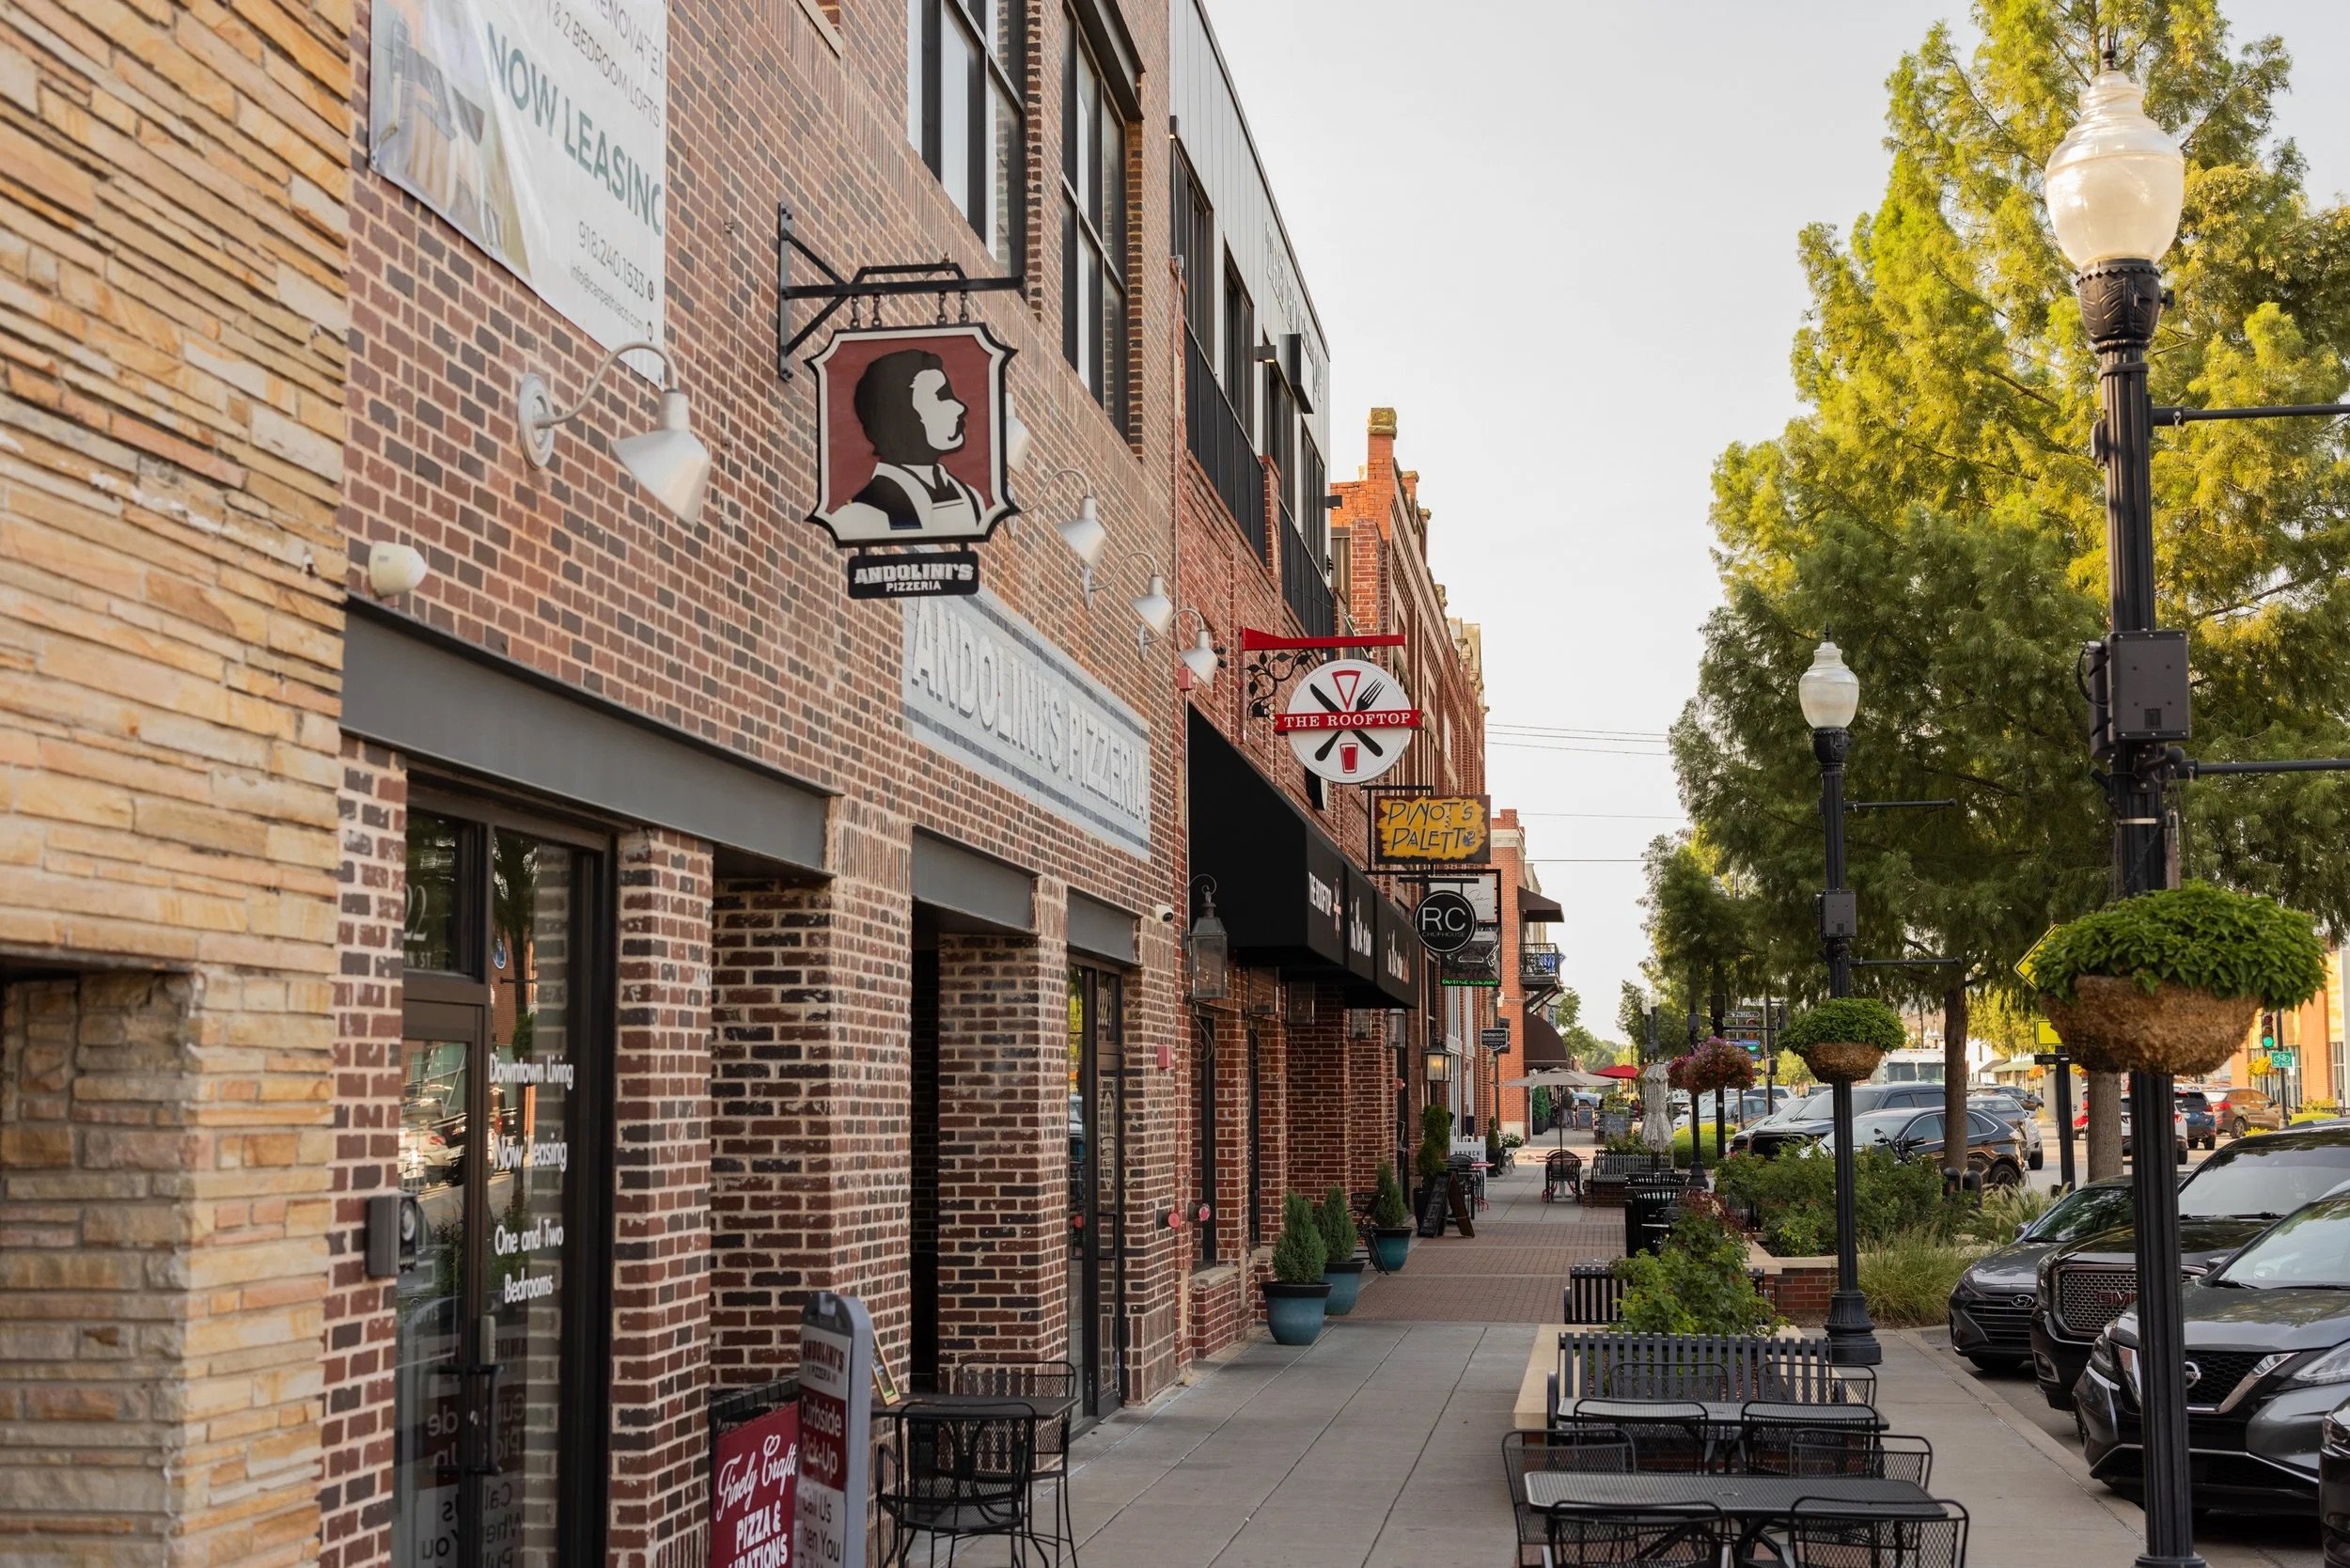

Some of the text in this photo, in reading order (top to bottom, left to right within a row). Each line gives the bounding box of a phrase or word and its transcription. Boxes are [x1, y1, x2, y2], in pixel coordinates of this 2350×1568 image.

[487, 21, 558, 138] NOW
[563, 11, 572, 38] 2
[572, 21, 627, 98] BEDROOM
[631, 80, 660, 128] LOFTS
[854, 563, 974, 584] ANDOLINI'S
[886, 581, 941, 592] PIZZERIA
[911, 596, 1147, 824] ANDOLINI'S PIZZERIA
[1284, 713, 1411, 729] THE ROOFTOP
[1422, 907, 1466, 931] RC
[489, 1053, 574, 1090] Downtown Living
[493, 1132, 568, 1172] Now easing
[494, 1216, 564, 1256] One and Two
[505, 1267, 554, 1304] Bedrooms
[801, 1394, 842, 1438] Curbside
[802, 1432, 838, 1479] Pick-Up
[716, 1451, 758, 1522] Finely
[735, 1499, 781, 1555] PIZZA &
[819, 1495, 832, 1523] Us
[728, 1533, 788, 1568] TIONS
[820, 1529, 840, 1563] You
